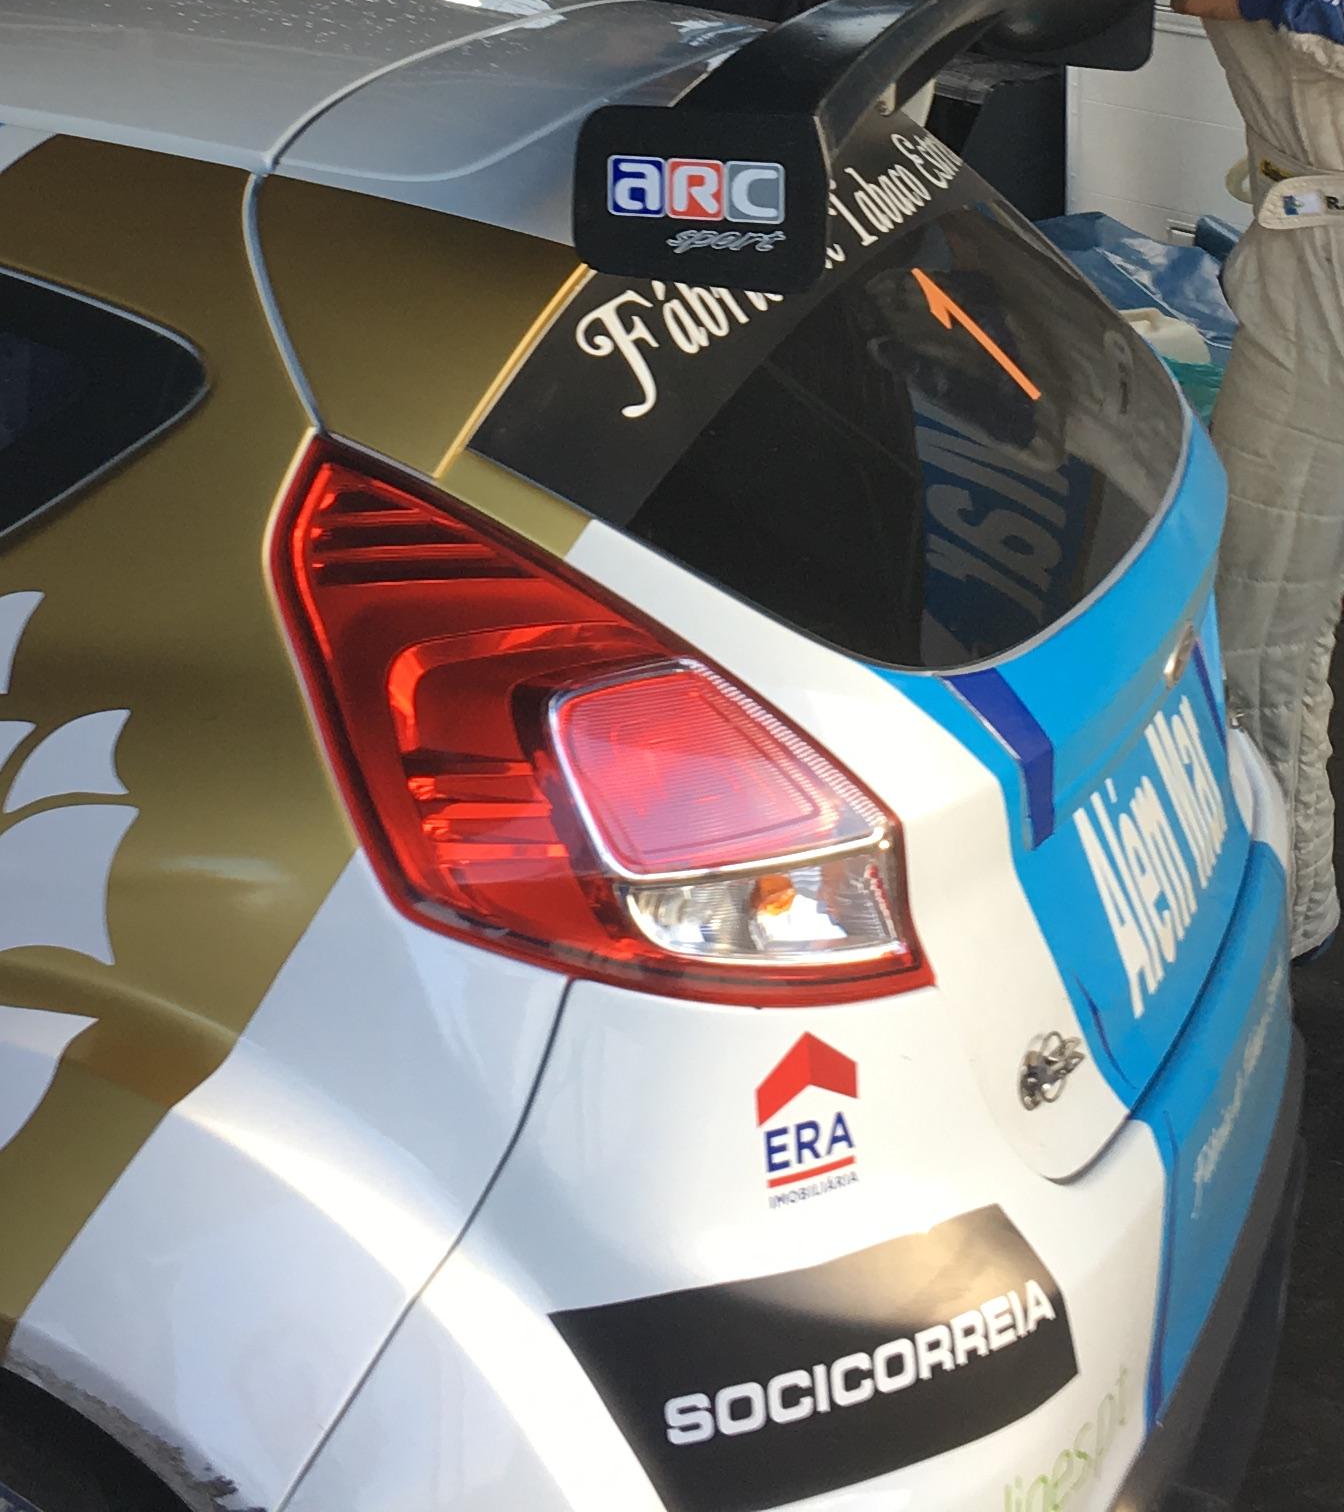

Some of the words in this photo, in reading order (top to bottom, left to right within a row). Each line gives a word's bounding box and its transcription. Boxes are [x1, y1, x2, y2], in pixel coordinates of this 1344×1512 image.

[666, 229, 786, 254] sport
[764, 1111, 855, 1174] ERA
[663, 1279, 1057, 1446] SOCICORREIA
